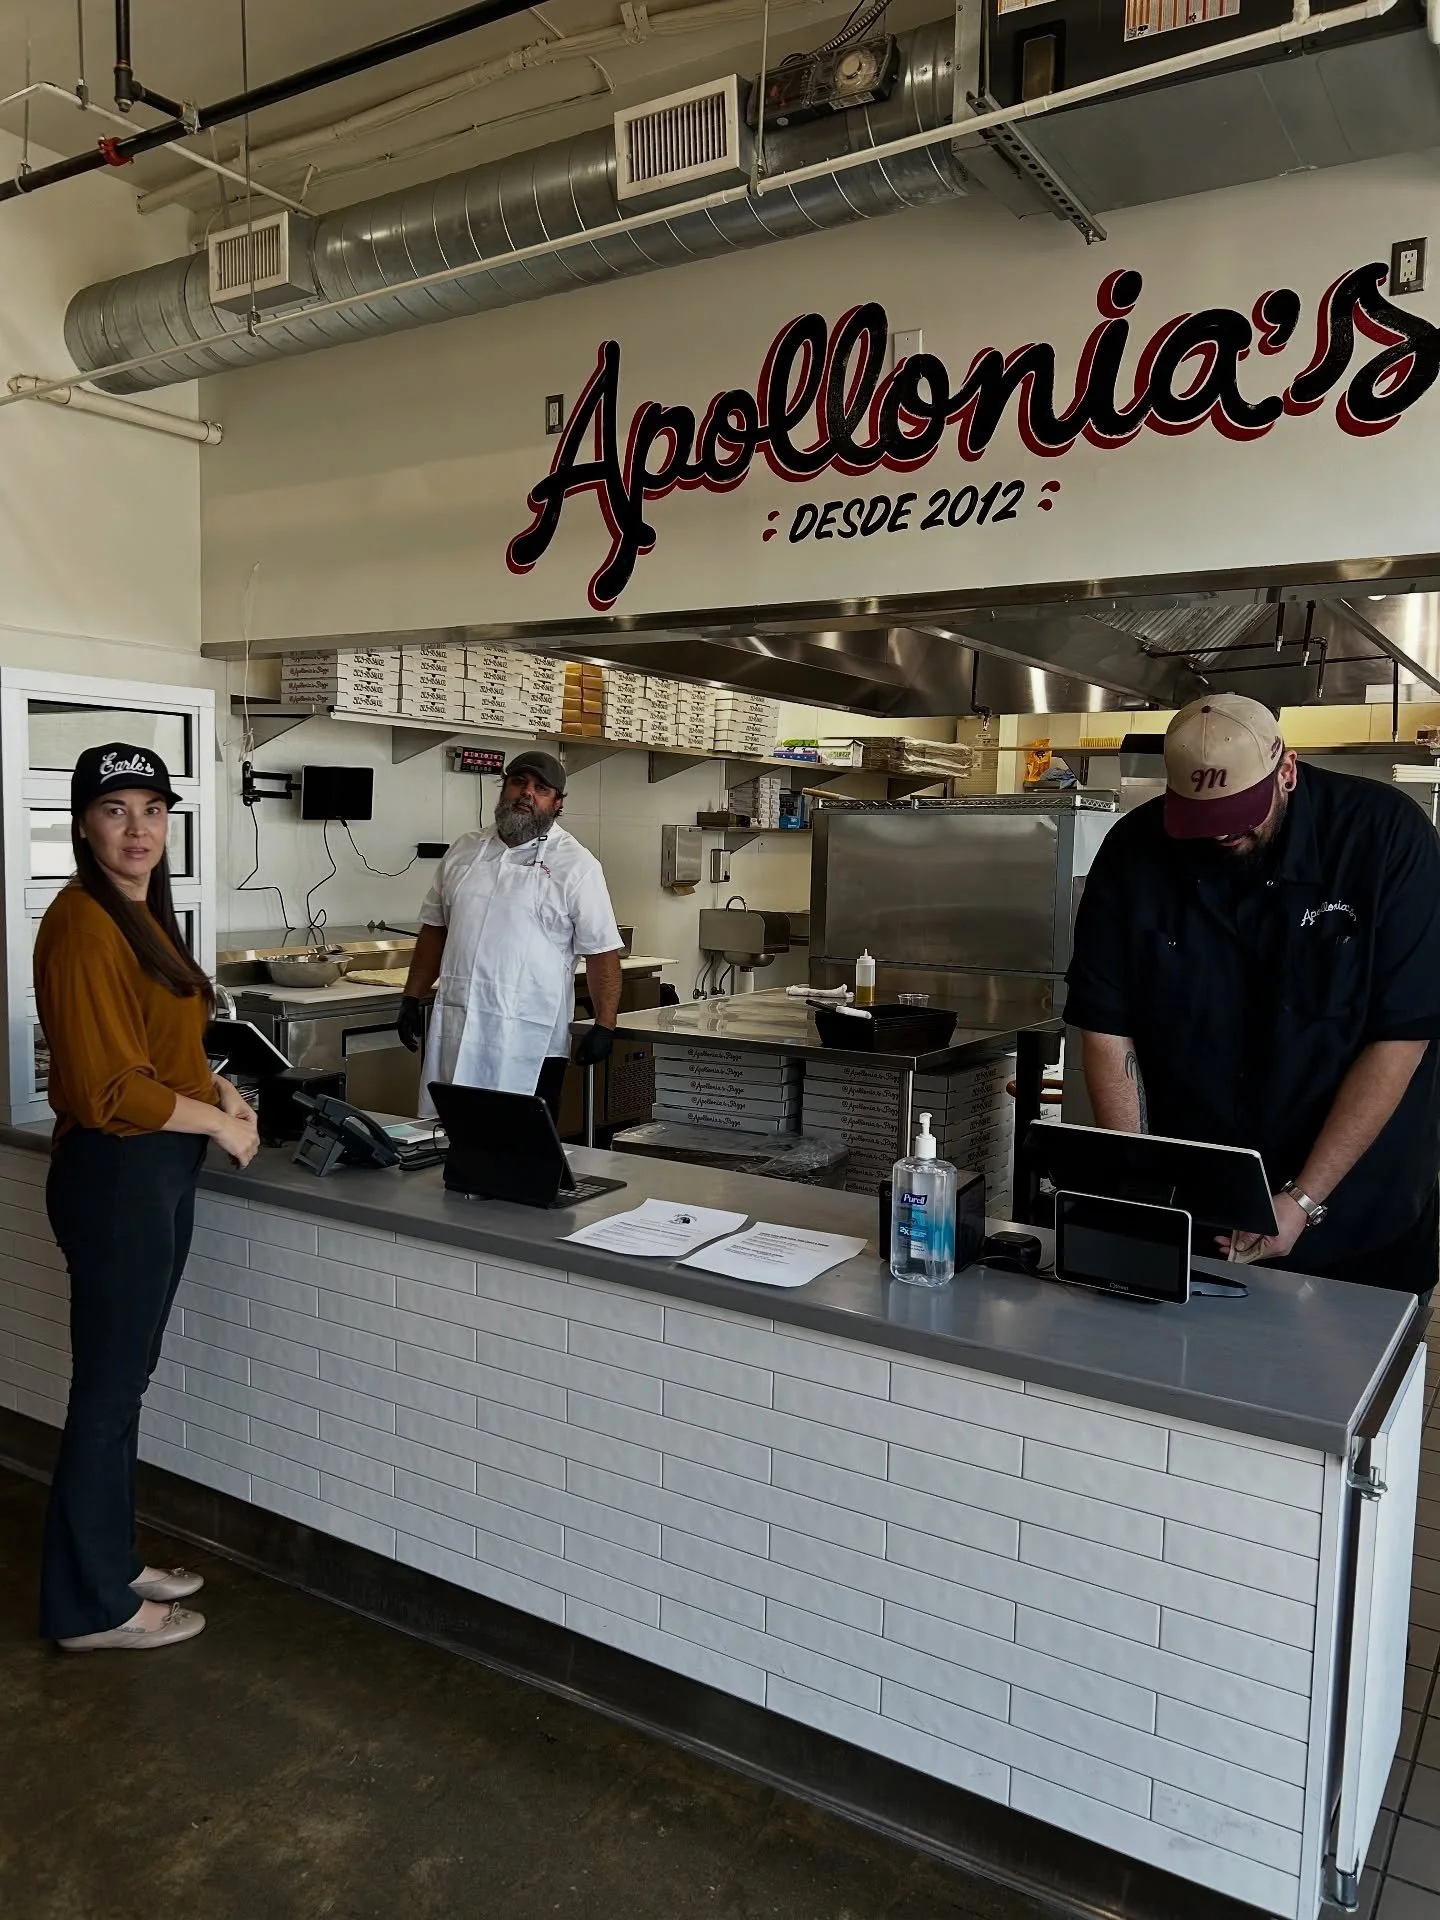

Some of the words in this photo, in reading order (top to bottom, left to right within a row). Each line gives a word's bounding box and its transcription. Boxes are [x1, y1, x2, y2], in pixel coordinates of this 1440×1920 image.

[507, 262, 1440, 610] Apollonia's
[788, 492, 918, 544] DESDE
[919, 479, 1026, 531] 2012
[100, 752, 154, 776] Earle's
[1300, 900, 1357, 927] Apollonia's
